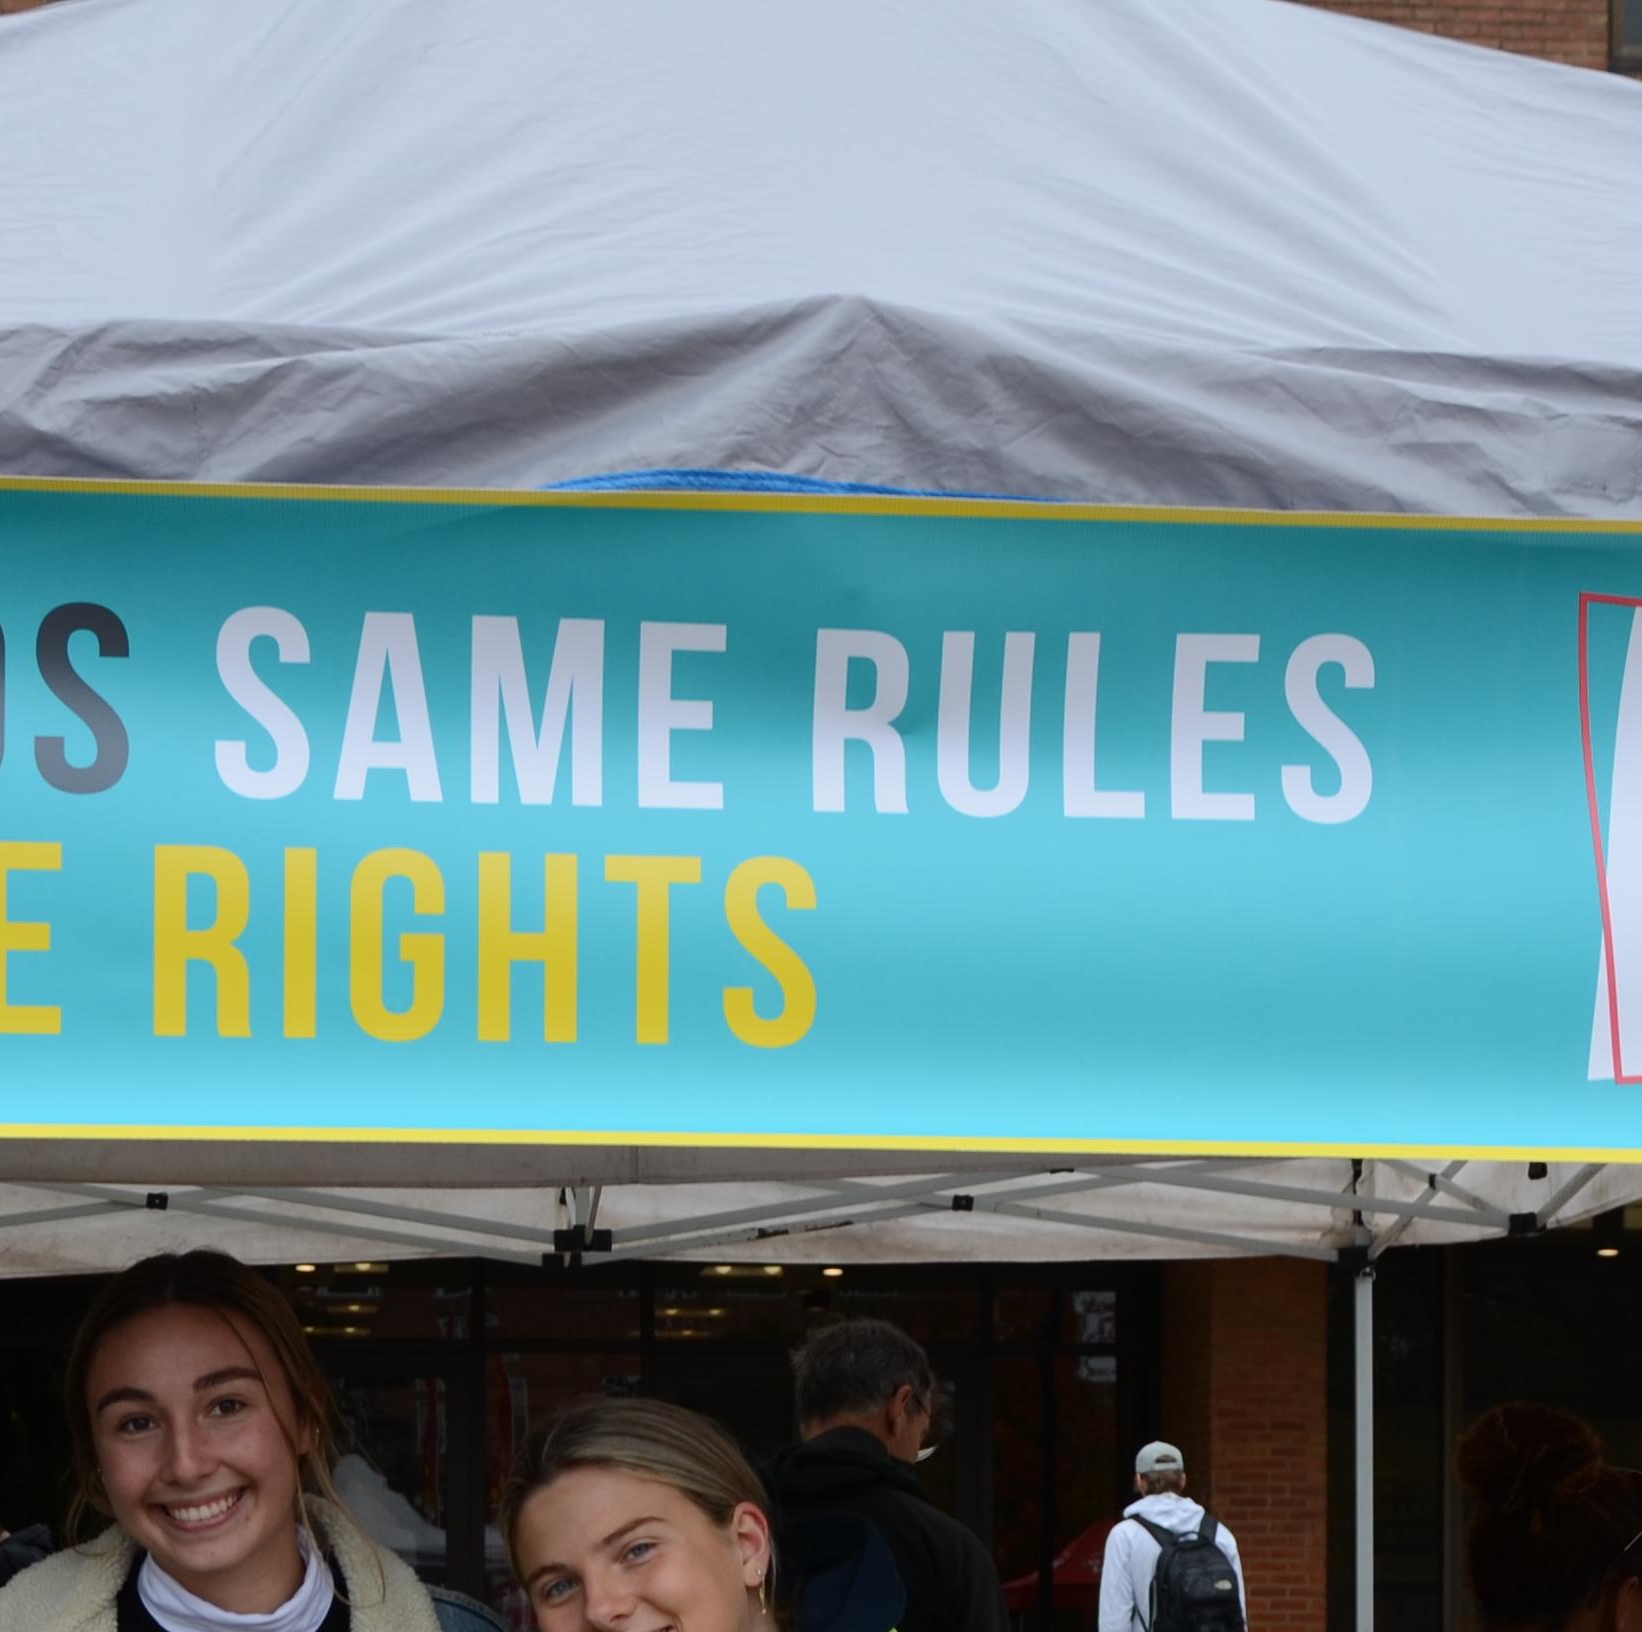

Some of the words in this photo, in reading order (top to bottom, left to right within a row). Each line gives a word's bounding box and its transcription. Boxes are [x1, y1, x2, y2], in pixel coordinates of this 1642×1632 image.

[214, 605, 728, 809] SAME
[812, 627, 1377, 825] RULES
[153, 843, 819, 1048] RIGHTS
